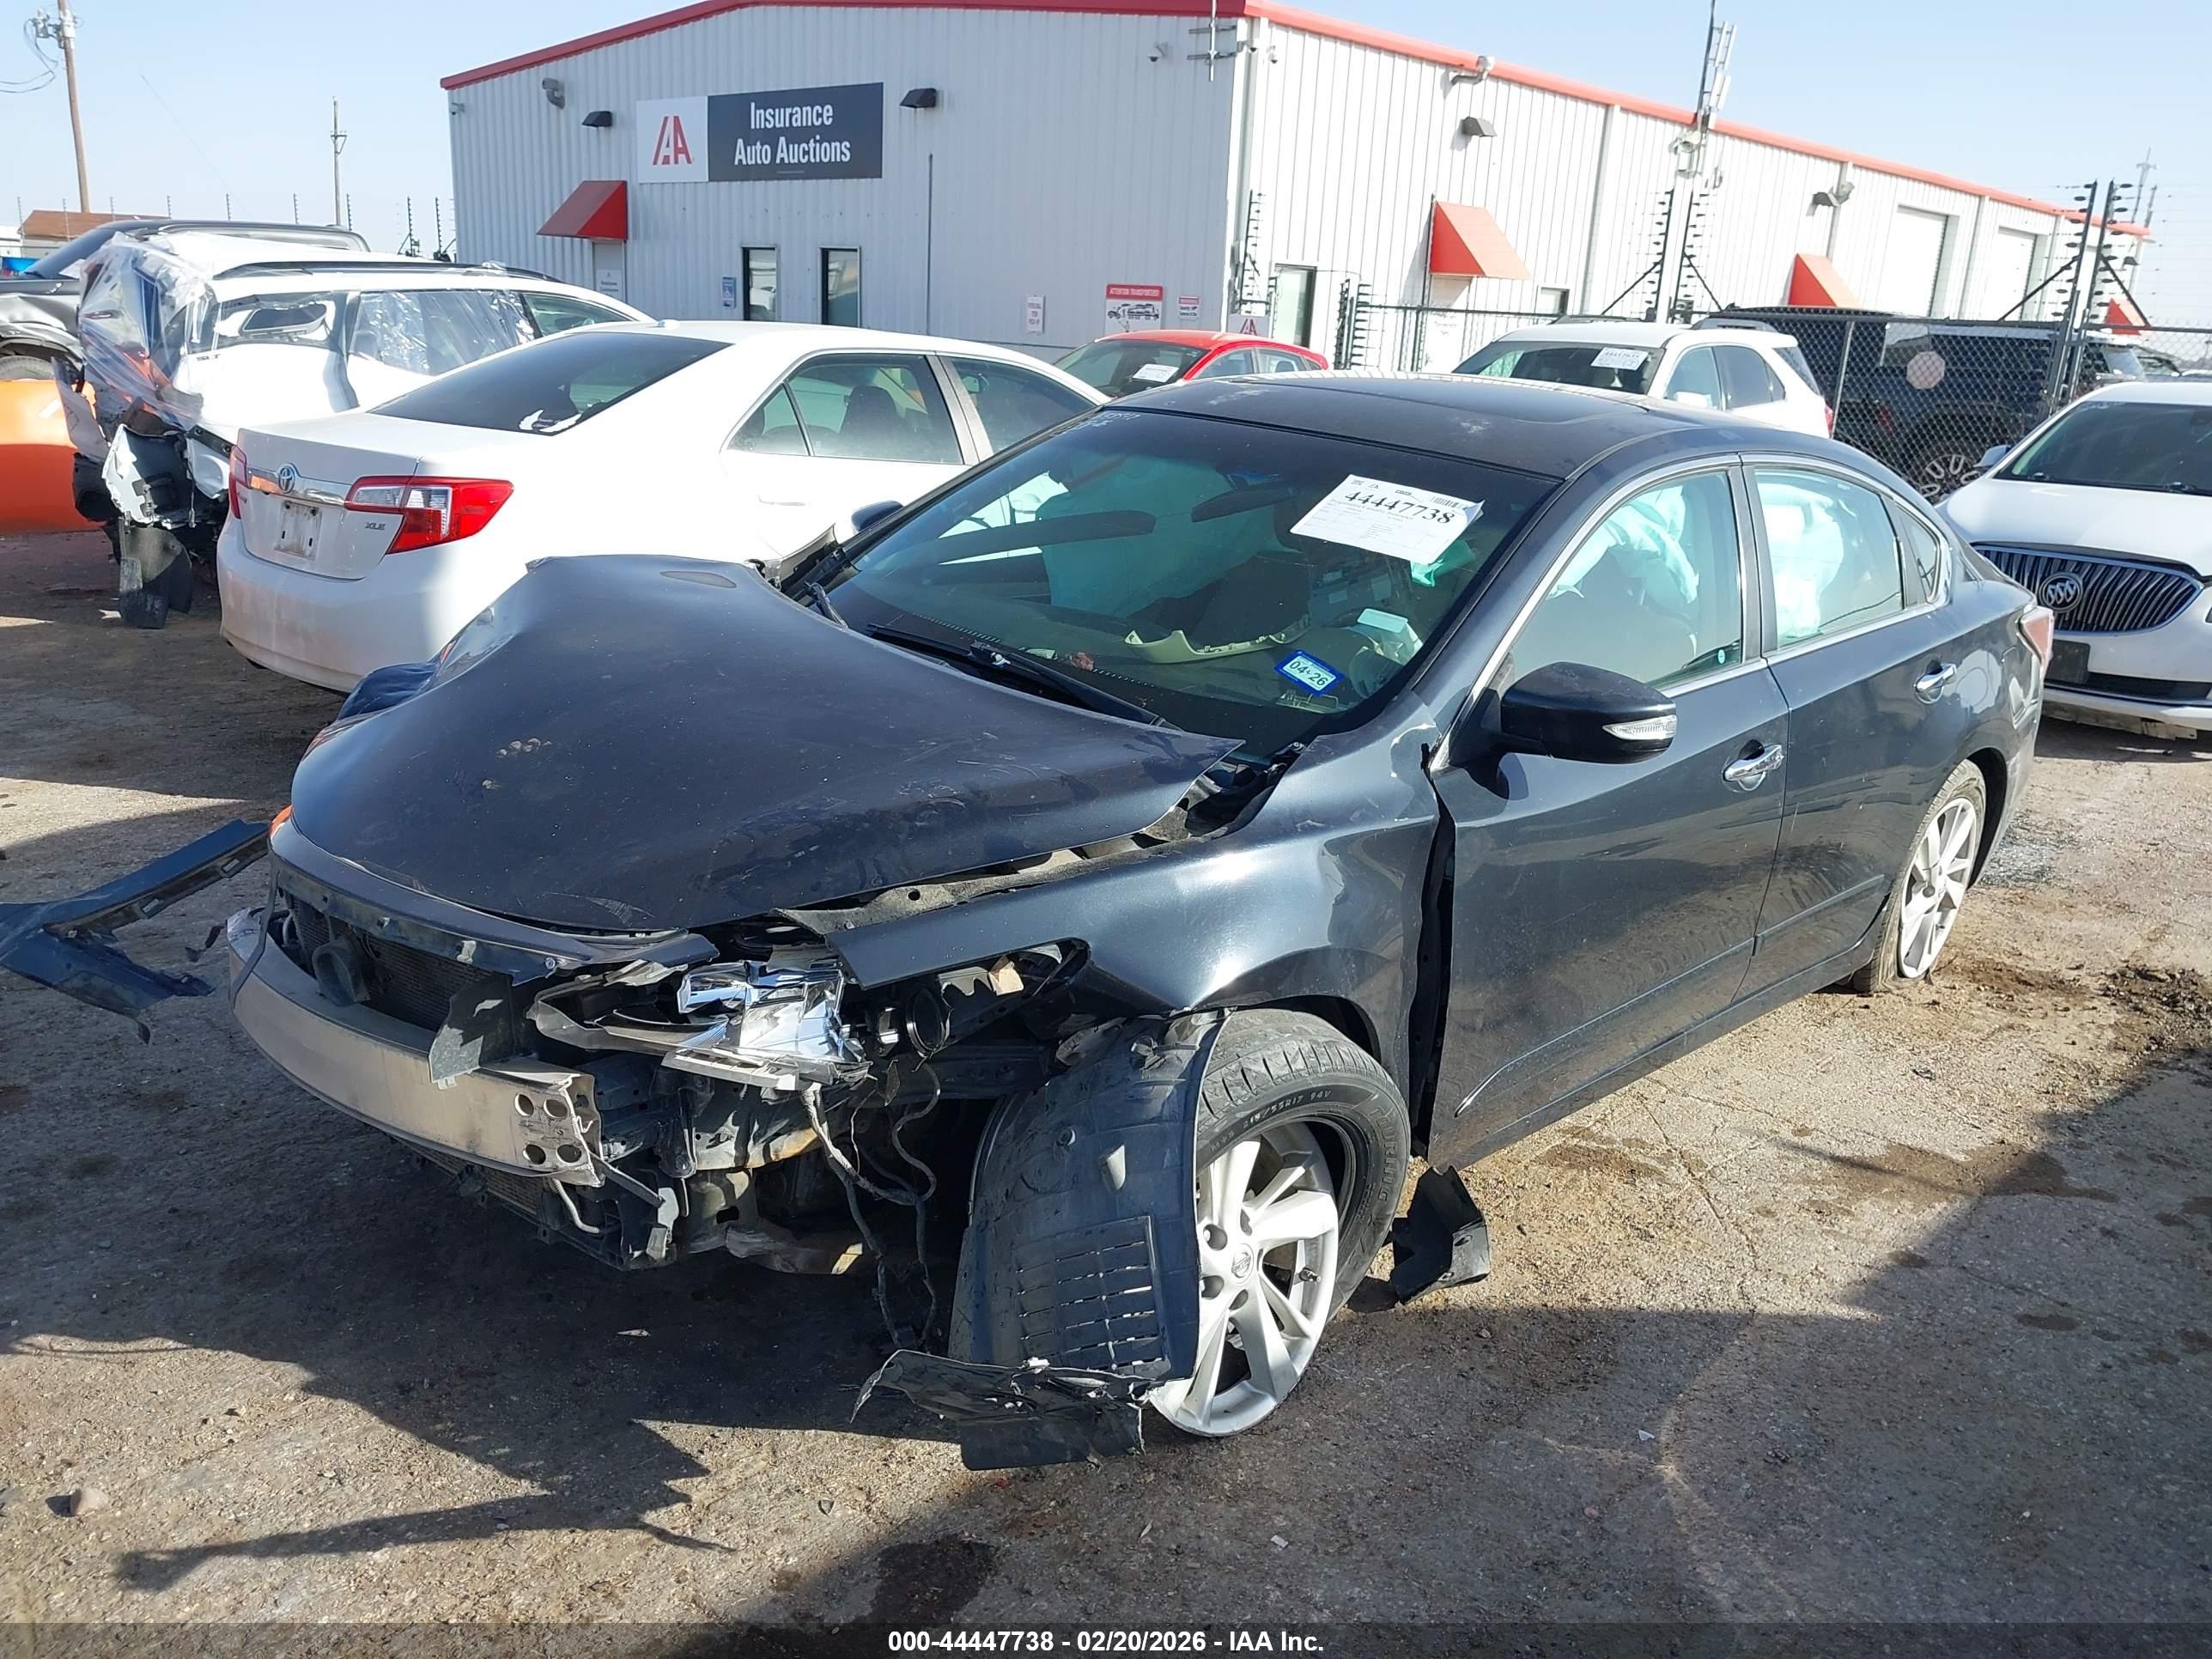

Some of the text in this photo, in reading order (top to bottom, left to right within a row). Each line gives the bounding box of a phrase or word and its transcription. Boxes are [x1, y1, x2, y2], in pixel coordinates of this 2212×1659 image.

[750, 101, 833, 130] Insurance
[734, 134, 851, 165] Auto Auctions
[1345, 491, 1455, 523] 44447738
[365, 521, 386, 531] XLE
